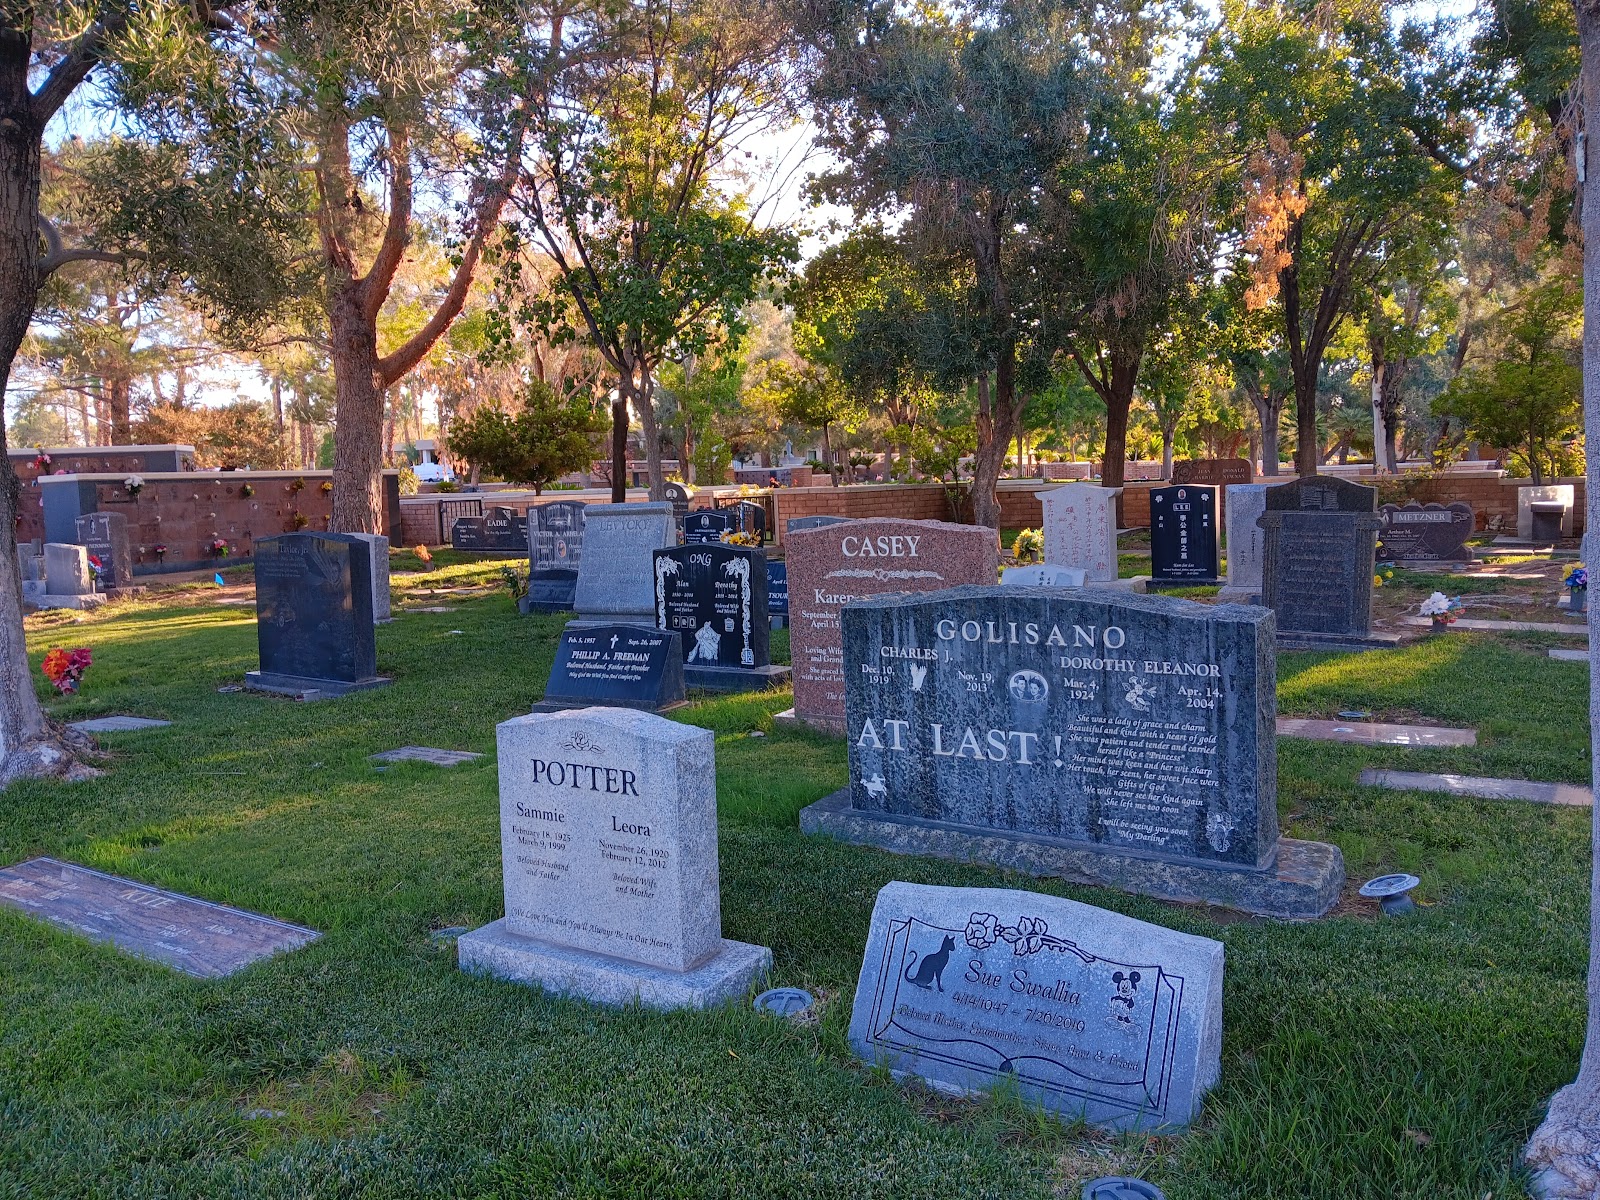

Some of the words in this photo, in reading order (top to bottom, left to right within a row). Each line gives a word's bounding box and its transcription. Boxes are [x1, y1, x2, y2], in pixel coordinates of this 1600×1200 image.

[842, 536, 920, 557] CASEY
[690, 553, 712, 566] ONG
[715, 581, 738, 590] Dorothy
[814, 589, 854, 604] Karen
[811, 620, 828, 629] April
[937, 619, 1125, 648] GOLISANO
[572, 651, 600, 659] PHILLIP
[602, 652, 610, 660] A.
[613, 652, 650, 661] FREEMAN
[805, 646, 826, 655] Loving
[828, 647, 843, 655] Wife
[881, 646, 938, 659] CHARLES
[945, 650, 953, 662] J.
[862, 664, 880, 674] Dec.
[882, 666, 895, 675] 10,
[1060, 657, 1136, 671] DOROTHY
[1144, 661, 1220, 677] ELEANOR
[870, 676, 889, 684] 1919
[958, 671, 977, 681] Nov.
[981, 673, 994, 682] 19,
[1064, 678, 1087, 688] Mar.
[1090, 681, 1099, 690] 4,
[967, 682, 987, 691] 2013
[1178, 686, 1201, 697] Apr.
[826, 692, 837, 700] The
[1071, 690, 1095, 700] 1924
[1187, 698, 1214, 709] 2004
[1115, 717, 1131, 728] lady
[1133, 720, 1141, 728] of
[1142, 721, 1163, 729] grace
[1182, 724, 1206, 732] charm
[857, 717, 909, 750] AT
[931, 723, 1037, 765] LAST
[1054, 736, 1062, 767] !
[1068, 724, 1102, 734] Beautiful
[1120, 728, 1137, 737] kind
[1140, 730, 1157, 738] with
[1167, 732, 1186, 740] heart
[1189, 735, 1197, 743] of
[1199, 735, 1217, 745] gold
[1069, 734, 1082, 742] She
[1100, 738, 1127, 747] patient
[1146, 741, 1170, 750] tender
[1188, 746, 1216, 754] carried
[1097, 746, 1122, 757] herself
[1124, 748, 1137, 758] like
[1073, 754, 1086, 762] Her
[1126, 760, 1142, 769] keen
[1161, 763, 1173, 771] her
[1191, 767, 1212, 778] sharp
[531, 759, 638, 796] POTTER
[1118, 780, 1136, 790] Gifts
[1139, 782, 1147, 791] of
[1149, 783, 1165, 791] God
[517, 802, 565, 822] Sammie
[612, 816, 651, 836] Leora
[1104, 818, 1118, 826] will
[1121, 820, 1129, 828] be
[1132, 823, 1153, 833] seeing
[1155, 826, 1169, 834] you
[1171, 828, 1188, 836] soon
[513, 826, 540, 838] February
[555, 833, 570, 842] 1925
[519, 837, 538, 848] March
[540, 841, 547, 849] 9,
[549, 841, 565, 850] 1999
[599, 840, 634, 853] November
[637, 847, 646, 855] 26,
[651, 849, 669, 858] 1920
[517, 856, 540, 866] Beloved
[541, 860, 569, 871] Husband
[602, 850, 632, 863] February
[635, 856, 645, 866] 12,
[648, 858, 667, 868] 2012
[540, 872, 559, 880] Father
[613, 873, 638, 883] Beloved
[640, 878, 657, 889] Wife
[616, 886, 628, 894] and
[630, 888, 654, 898] Mother
[526, 911, 540, 922] Love
[542, 914, 554, 923] You
[556, 917, 567, 925] and
[590, 925, 613, 938] Always
[635, 935, 647, 943] Our
[650, 939, 672, 949] Hearts
[965, 960, 1002, 988] Sue
[1010, 970, 1081, 1006] Swallia
[953, 992, 1007, 1015] 4/14/1947
[899, 1005, 930, 1021] Beloved
[1067, 1045, 1090, 1060] Aunt
[1095, 1051, 1104, 1061] &
[1109, 1054, 1138, 1071] Friend
